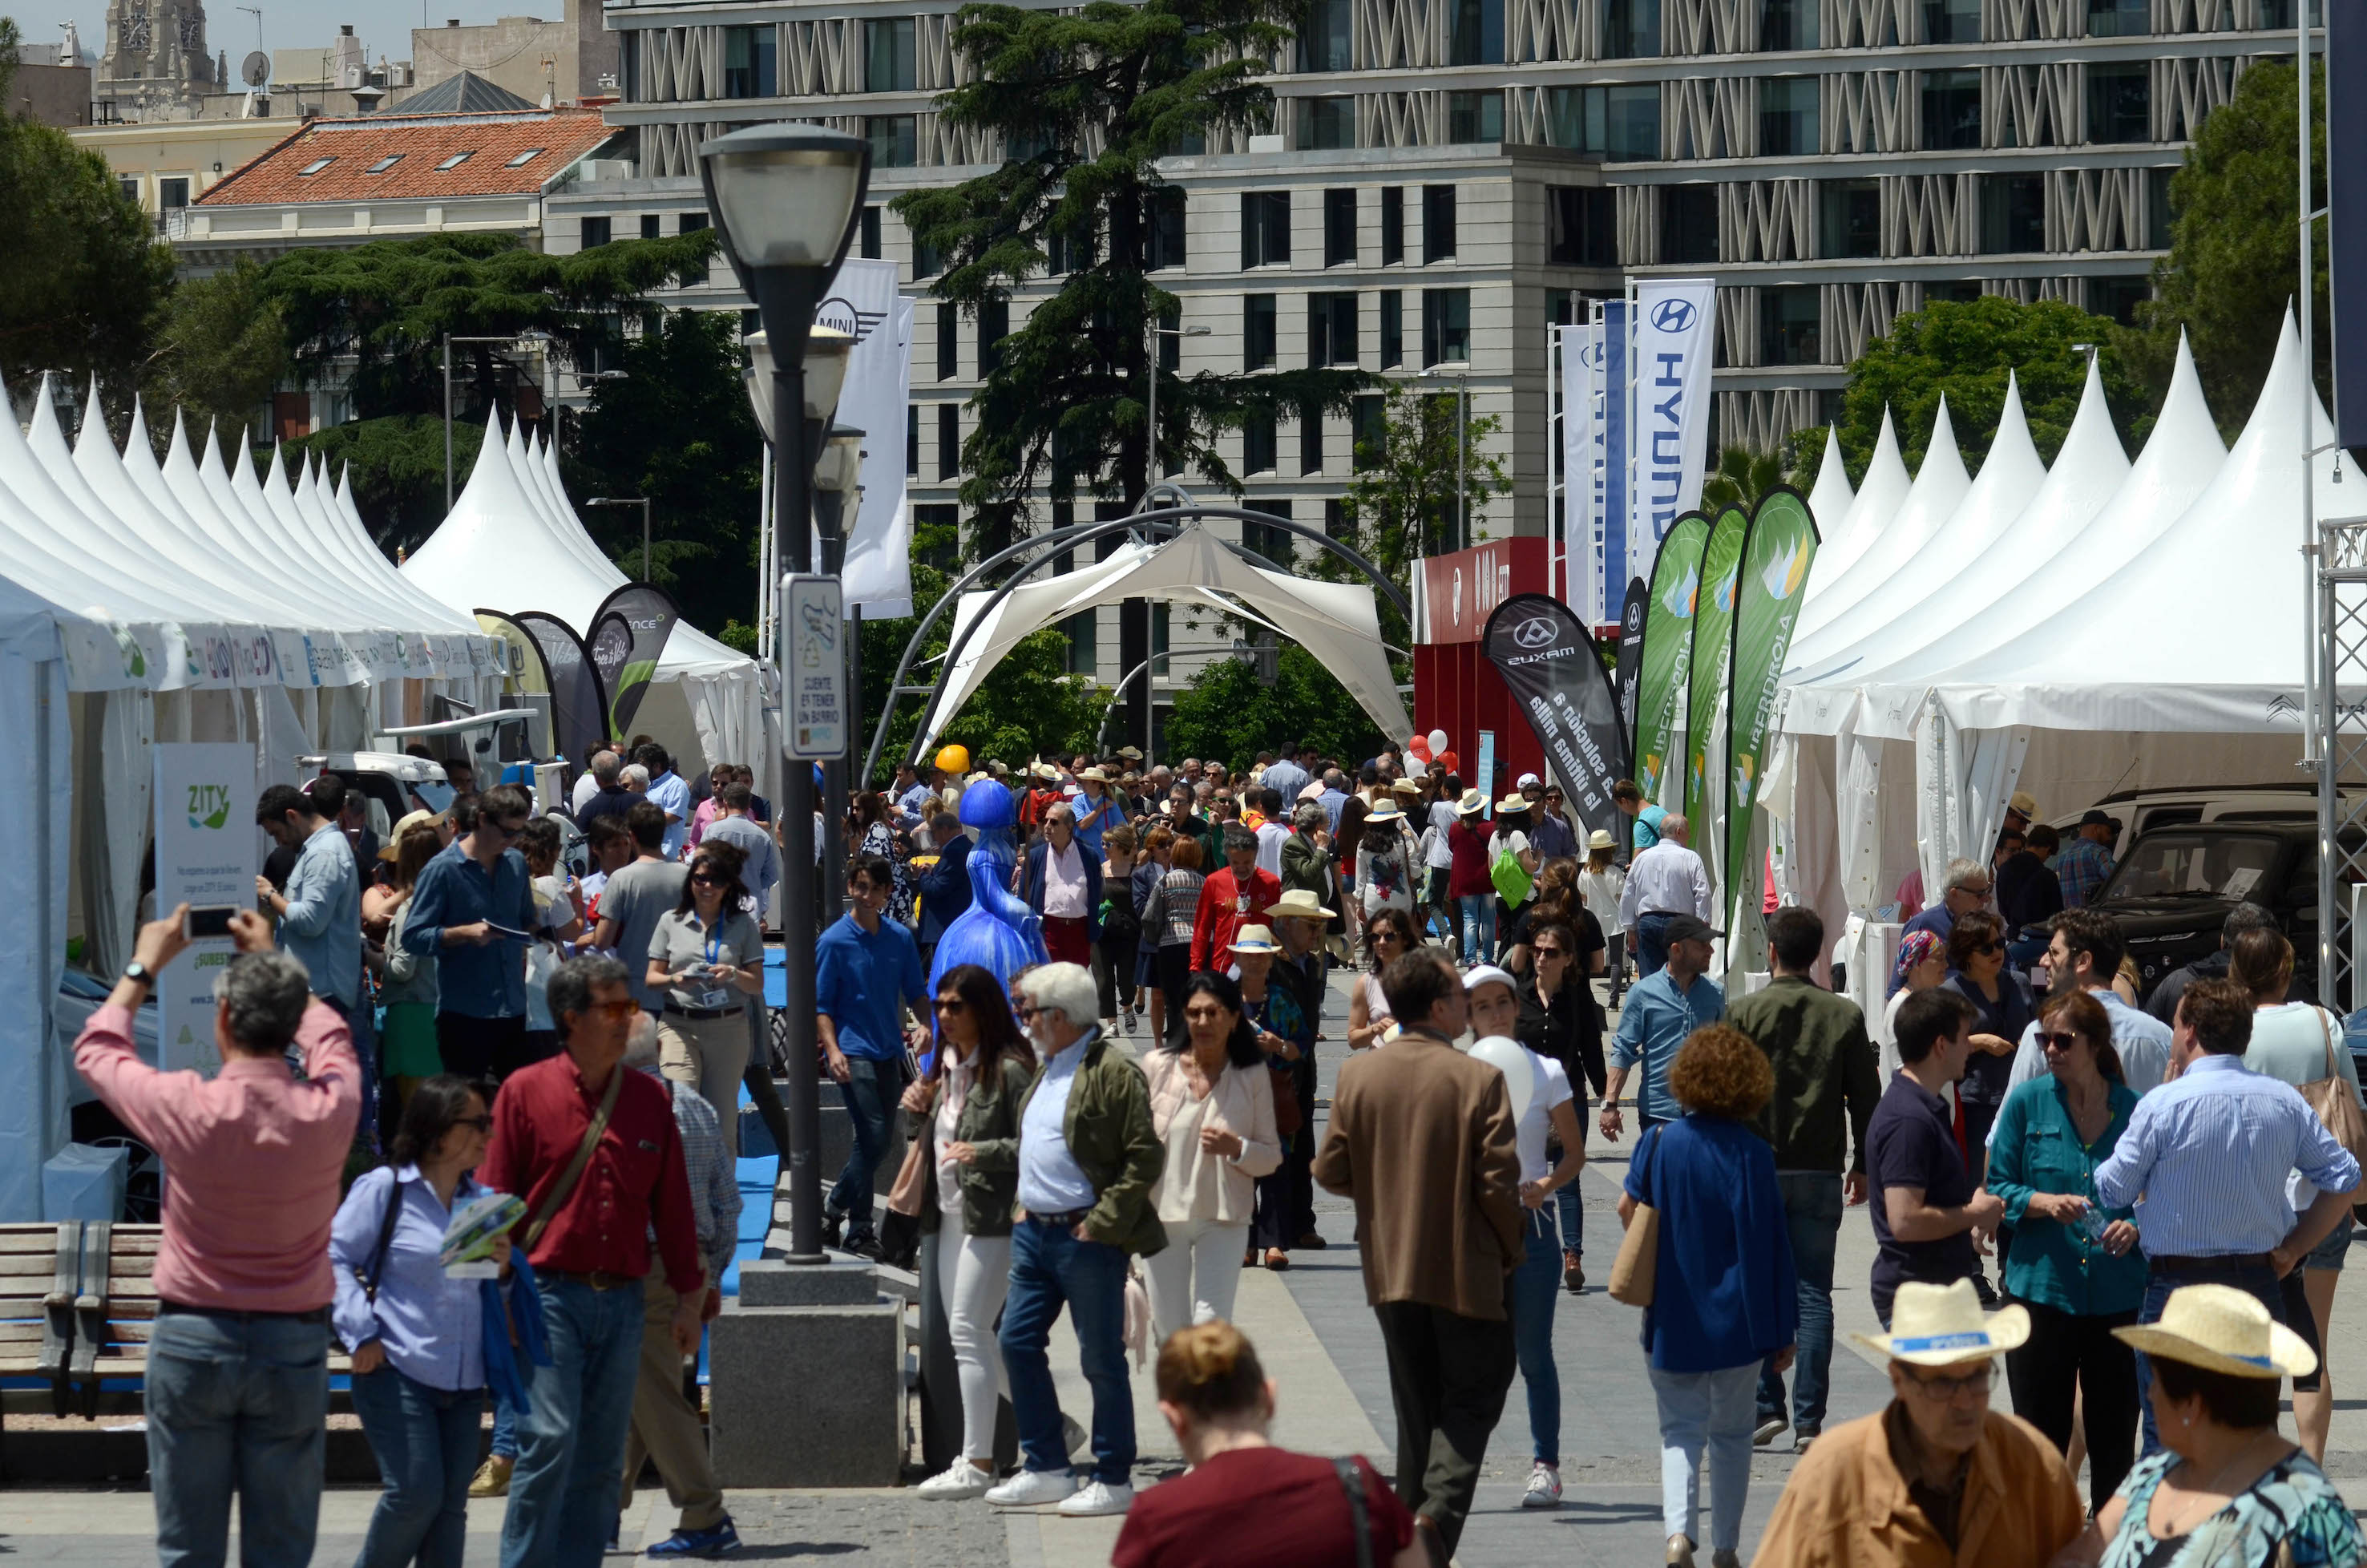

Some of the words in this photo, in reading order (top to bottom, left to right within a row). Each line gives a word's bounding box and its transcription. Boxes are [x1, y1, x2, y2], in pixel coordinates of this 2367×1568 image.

[820, 317, 852, 333] MINI
[1651, 353, 1683, 552] HYUND
[1750, 615, 1792, 751] IBERDROLA
[188, 785, 229, 814] ZITY
